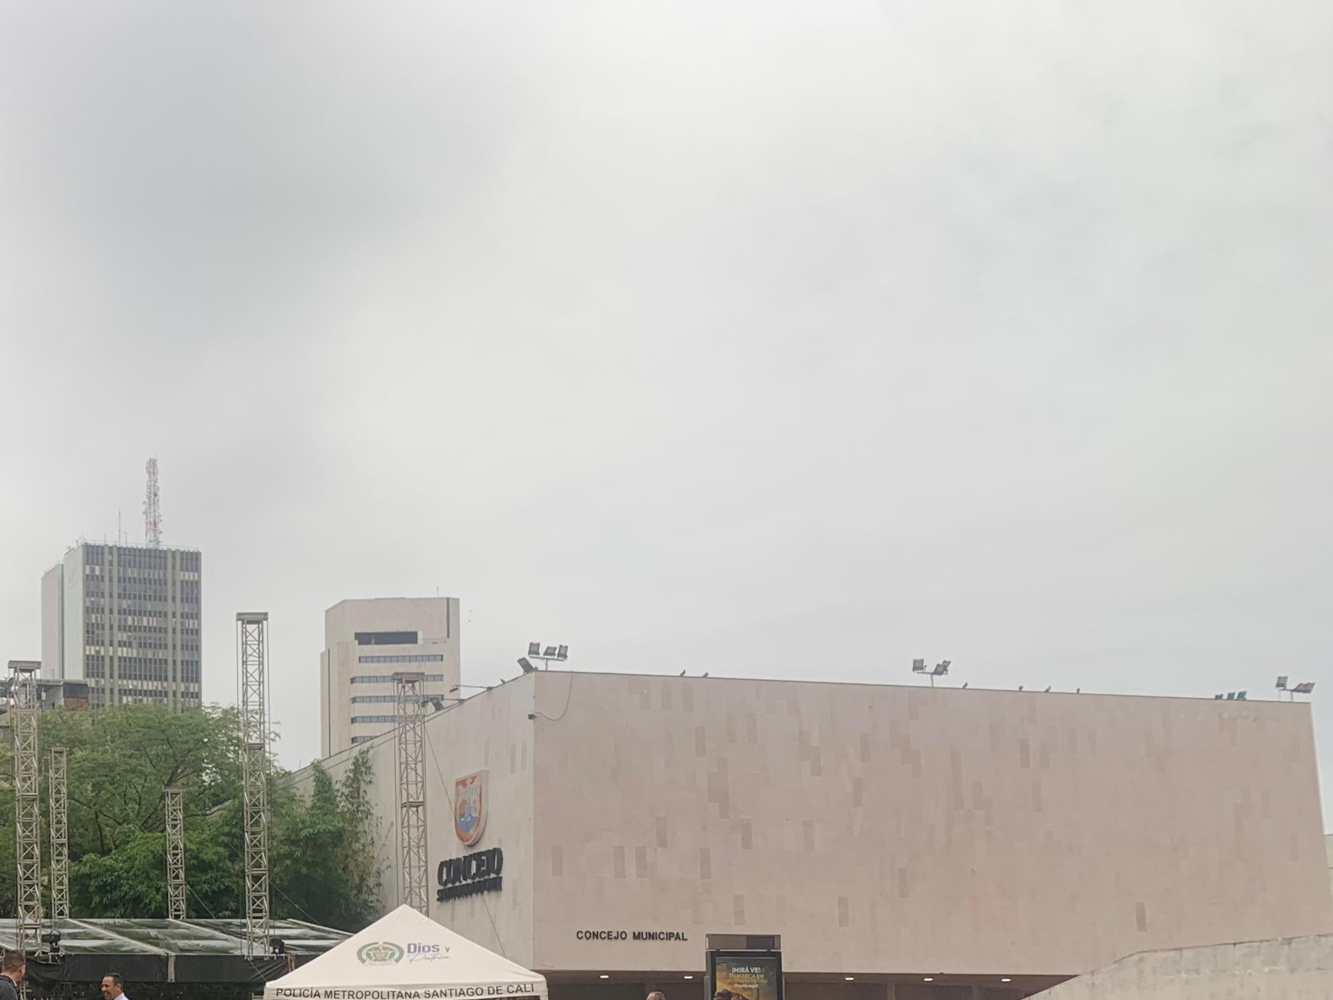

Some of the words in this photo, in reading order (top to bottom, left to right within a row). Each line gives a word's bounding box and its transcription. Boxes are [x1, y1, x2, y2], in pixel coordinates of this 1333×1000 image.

[576, 930, 628, 941] CONCEJO
[632, 931, 688, 941] MUNICIPAL
[407, 942, 440, 954] Dios
[276, 987, 321, 999] POLICÍA
[324, 989, 420, 999] METROPOLITANA
[424, 987, 484, 999] SANTIAGO
[487, 985, 503, 996] DE
[507, 983, 535, 994] CALI
